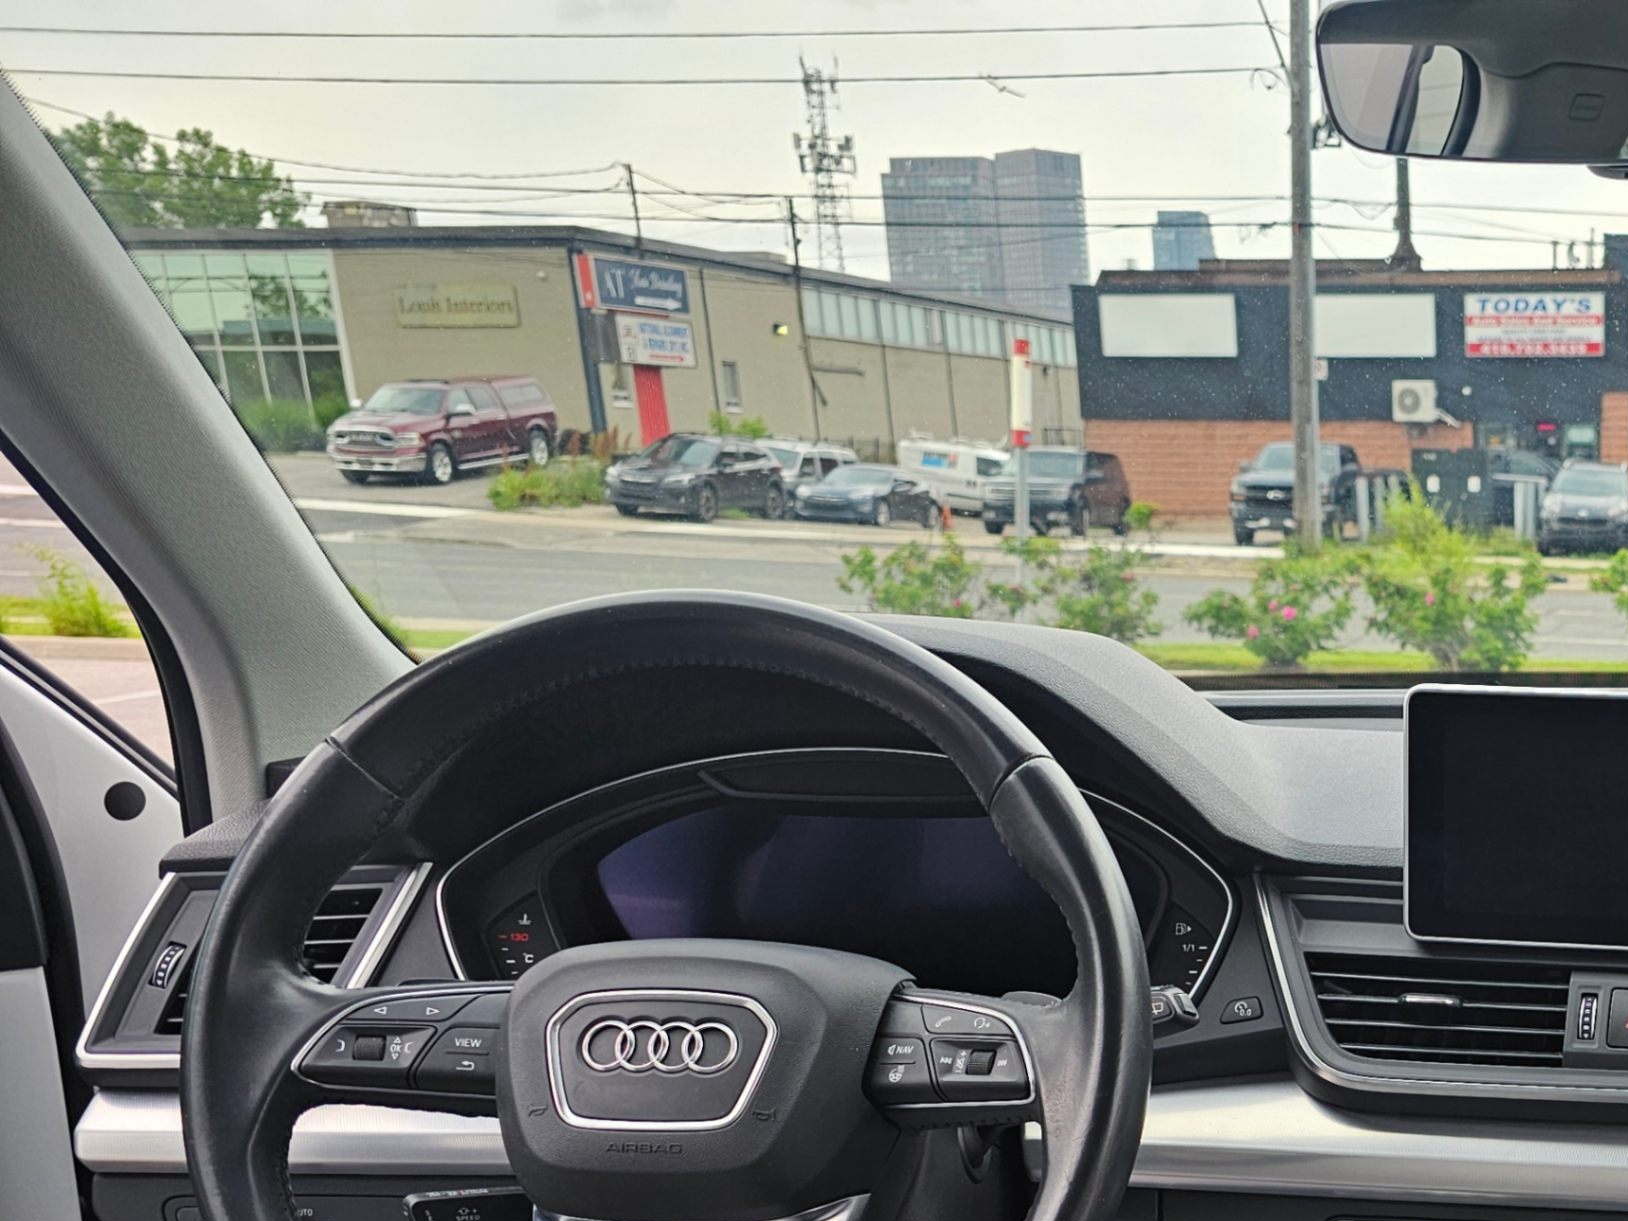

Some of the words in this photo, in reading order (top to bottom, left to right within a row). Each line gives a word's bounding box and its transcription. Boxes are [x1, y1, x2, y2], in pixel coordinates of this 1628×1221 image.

[1476, 298, 1592, 314] TODAY'S
[1182, 944, 1196, 952] 1/1
[454, 1037, 482, 1048] VIEW
[895, 1045, 914, 1054] NAV
[606, 1142, 682, 1154] AIRBAG
